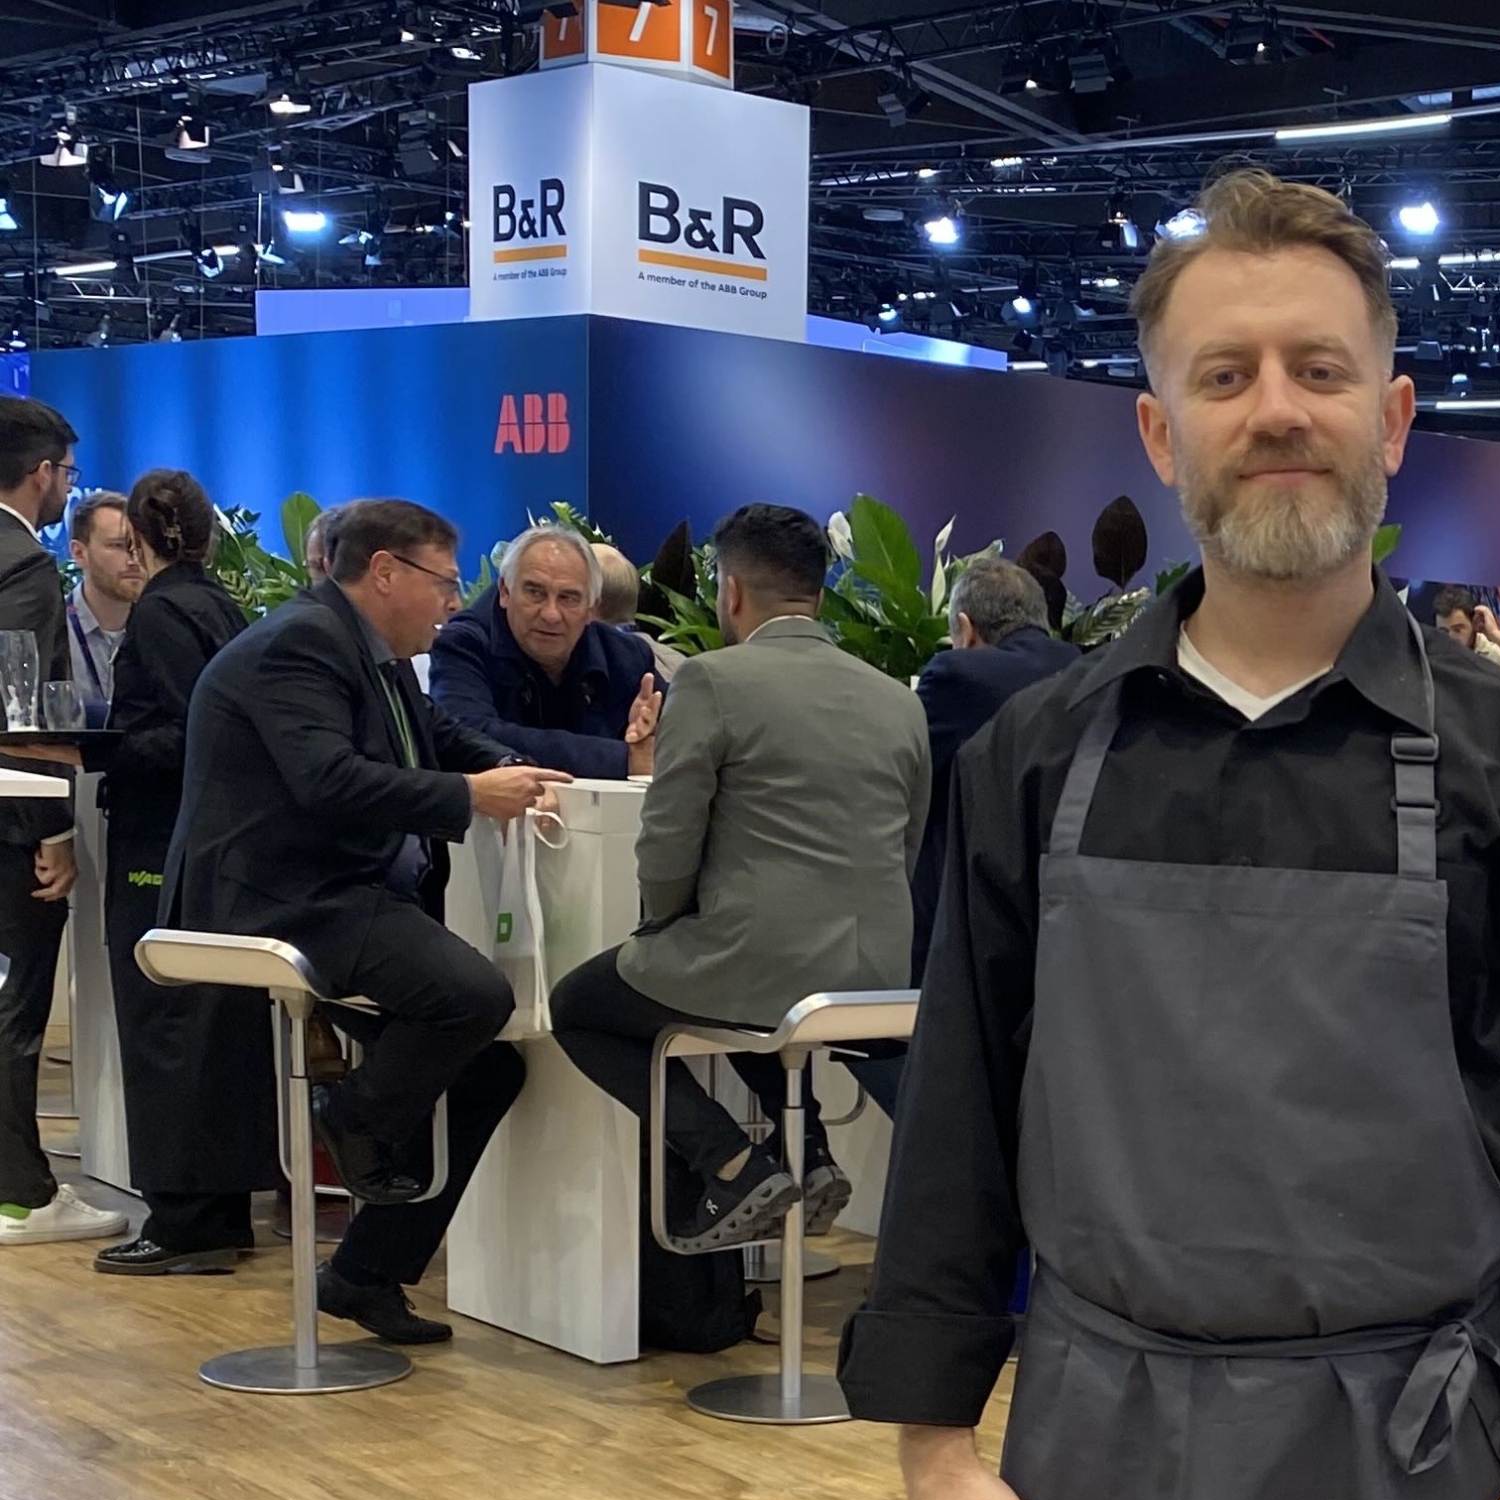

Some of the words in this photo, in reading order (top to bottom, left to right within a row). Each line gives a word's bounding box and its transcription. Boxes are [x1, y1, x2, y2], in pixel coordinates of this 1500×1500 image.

[704, 5, 718, 56] 7
[493, 178, 567, 242] B&R
[638, 181, 767, 260] B&R
[638, 271, 645, 280] A
[647, 273, 687, 287] member
[688, 279, 699, 288] of
[701, 281, 717, 292] the
[718, 283, 737, 294] ABB
[739, 286, 768, 300] Group
[494, 392, 570, 454] ABB
